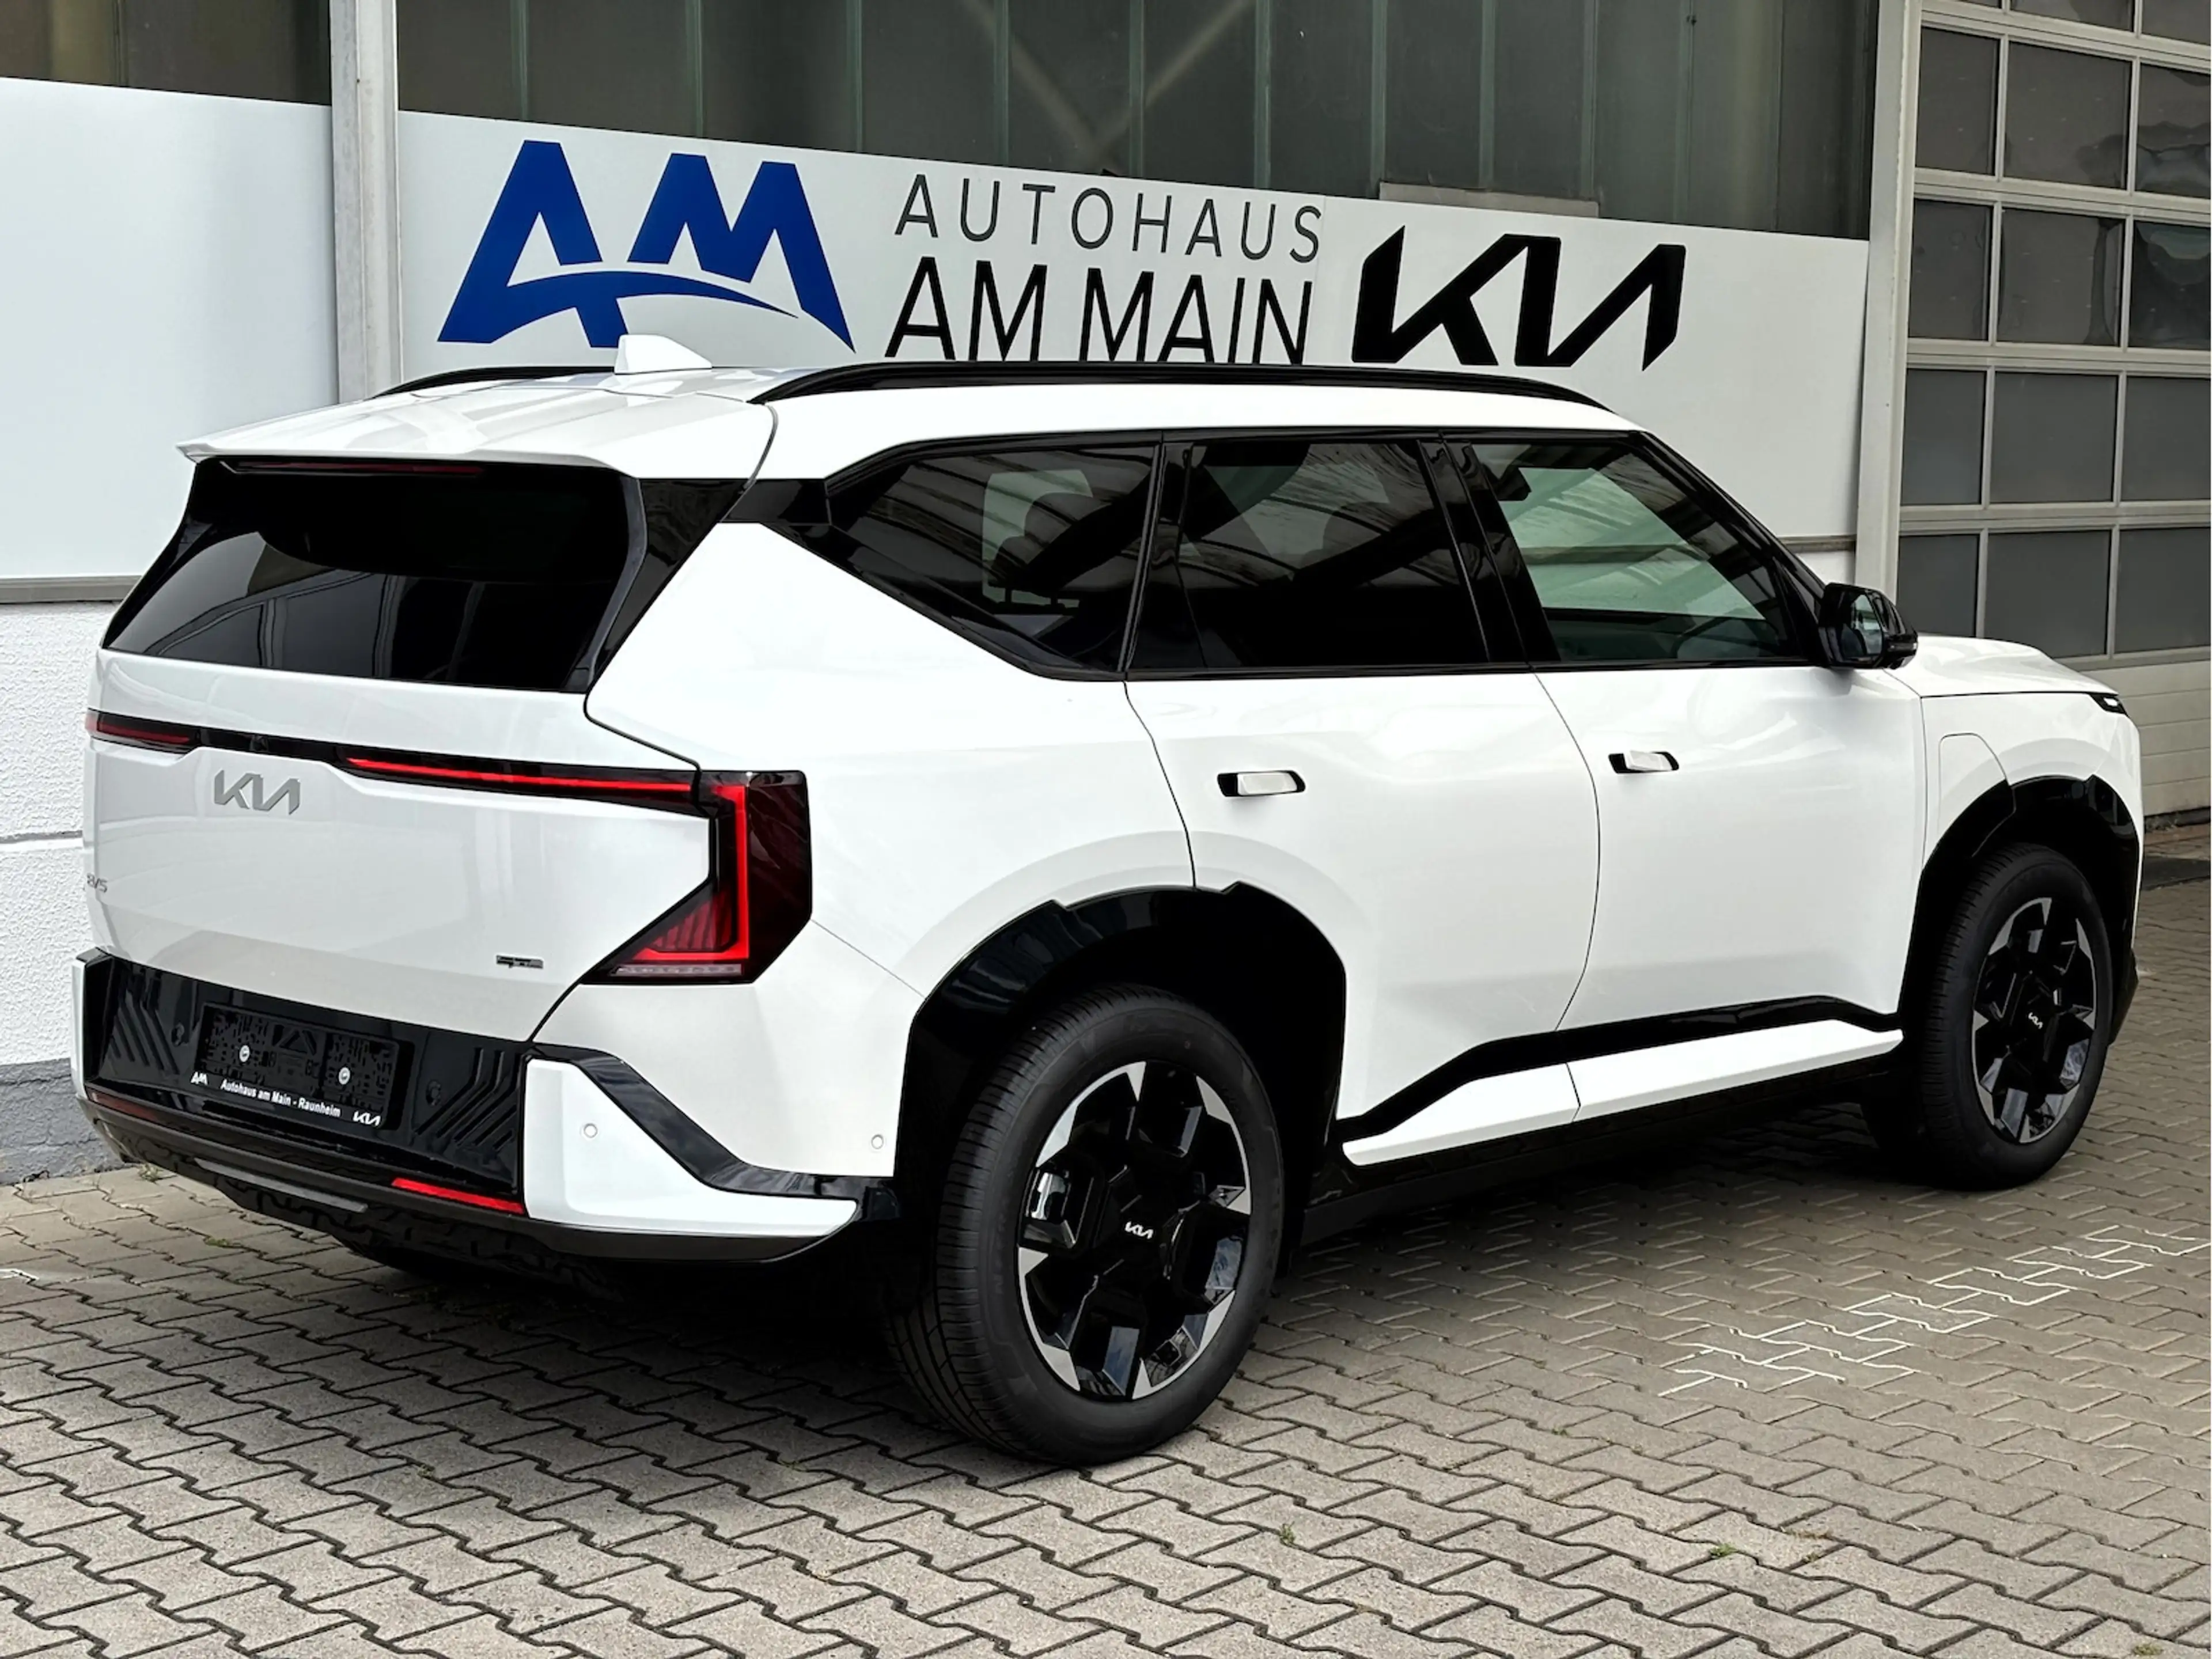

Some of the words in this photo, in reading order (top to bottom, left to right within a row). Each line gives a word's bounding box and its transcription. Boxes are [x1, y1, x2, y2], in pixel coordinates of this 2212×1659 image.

[895, 173, 1323, 263] AUTOHAUS
[885, 255, 1047, 362] AM
[1081, 267, 1313, 365] MAIN
[219, 1079, 257, 1097] Autohaus
[257, 1091, 271, 1101] am
[271, 1092, 292, 1106] Main
[298, 1098, 341, 1117] Raunheim
